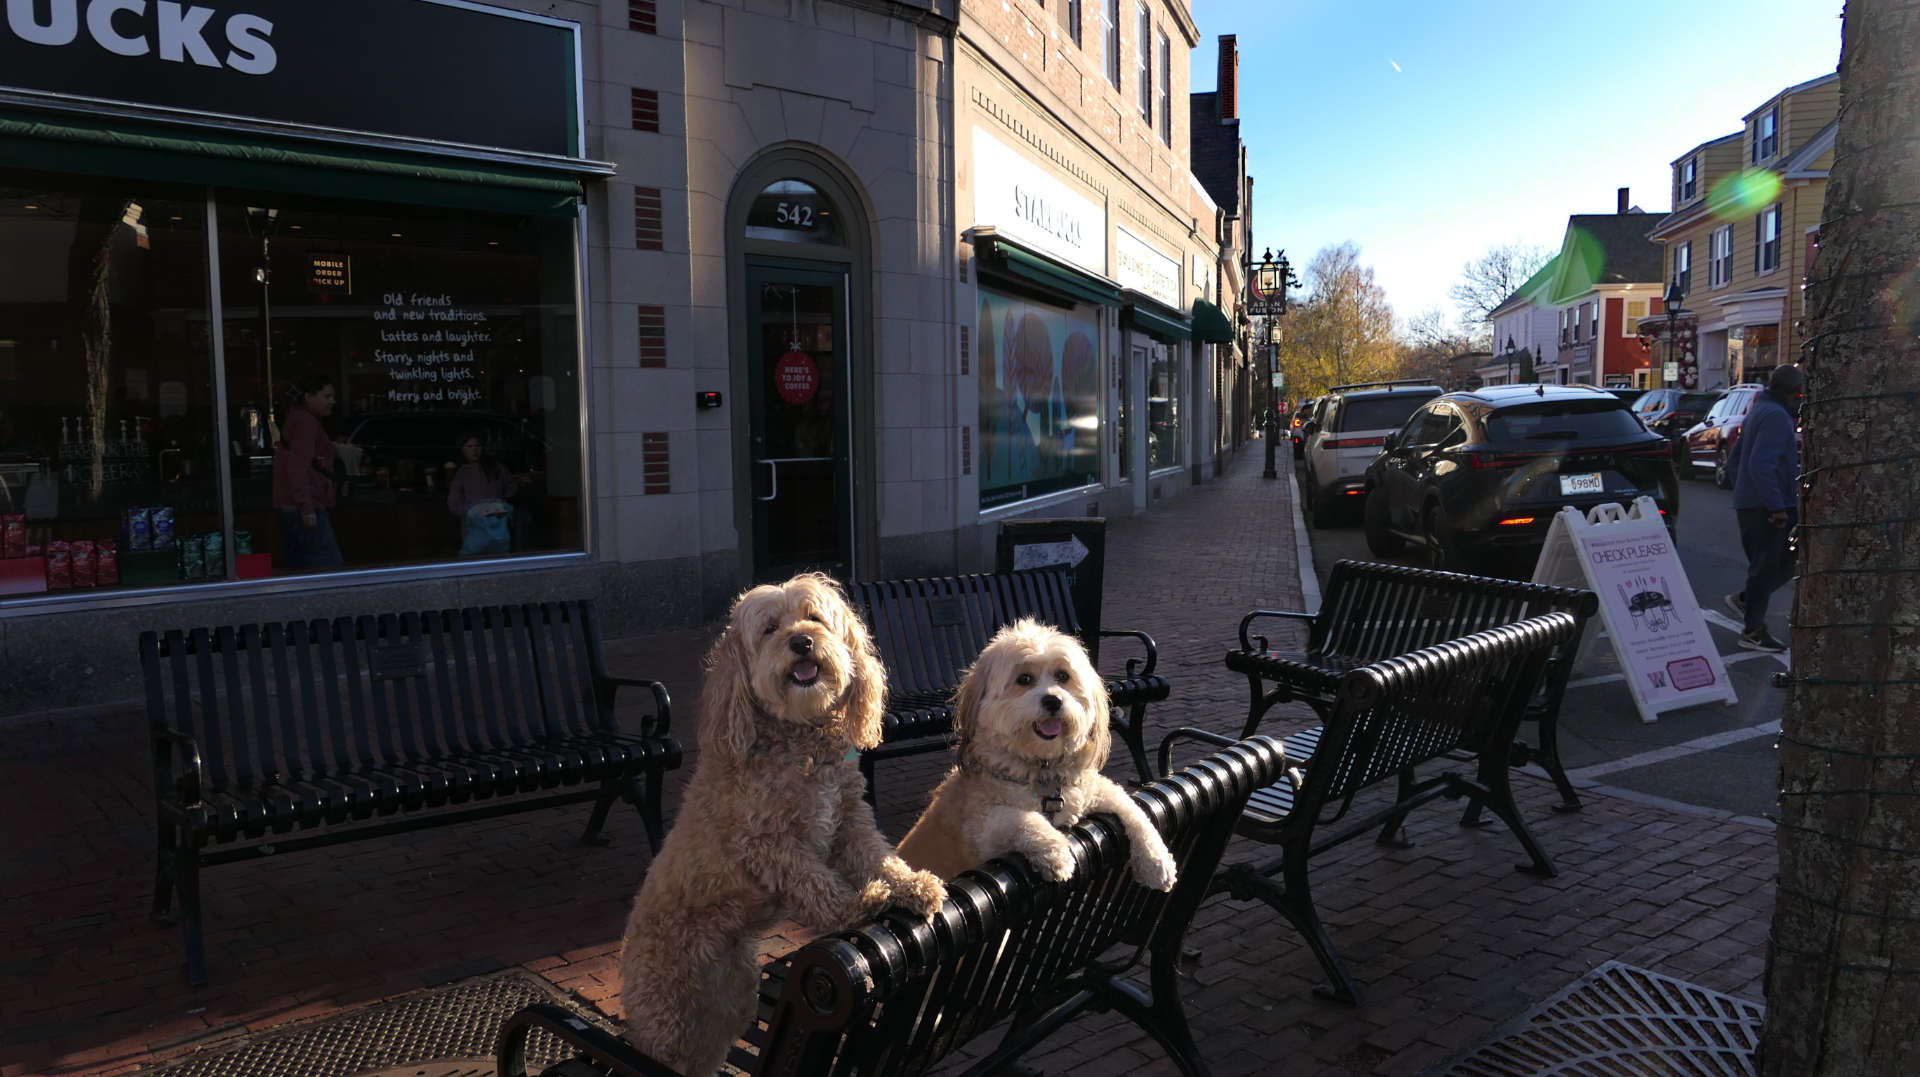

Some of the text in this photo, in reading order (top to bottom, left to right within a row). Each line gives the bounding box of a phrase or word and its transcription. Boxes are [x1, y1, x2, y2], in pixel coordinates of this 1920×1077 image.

[7, 0, 278, 75] UCKS
[777, 202, 813, 226] 542
[313, 260, 344, 268] MOBILE
[315, 269, 343, 277] ORDER
[383, 292, 452, 306] Old friends
[374, 308, 397, 321] and
[403, 311, 425, 321] new
[380, 328, 419, 342] Lattes
[422, 329, 441, 341] and
[417, 350, 450, 365] nights
[453, 349, 475, 362] and
[389, 367, 437, 382] twinkling
[781, 374, 792, 382] TO
[387, 389, 420, 403] Merry
[423, 388, 444, 401] and
[1591, 548, 1628, 564] CHECK
